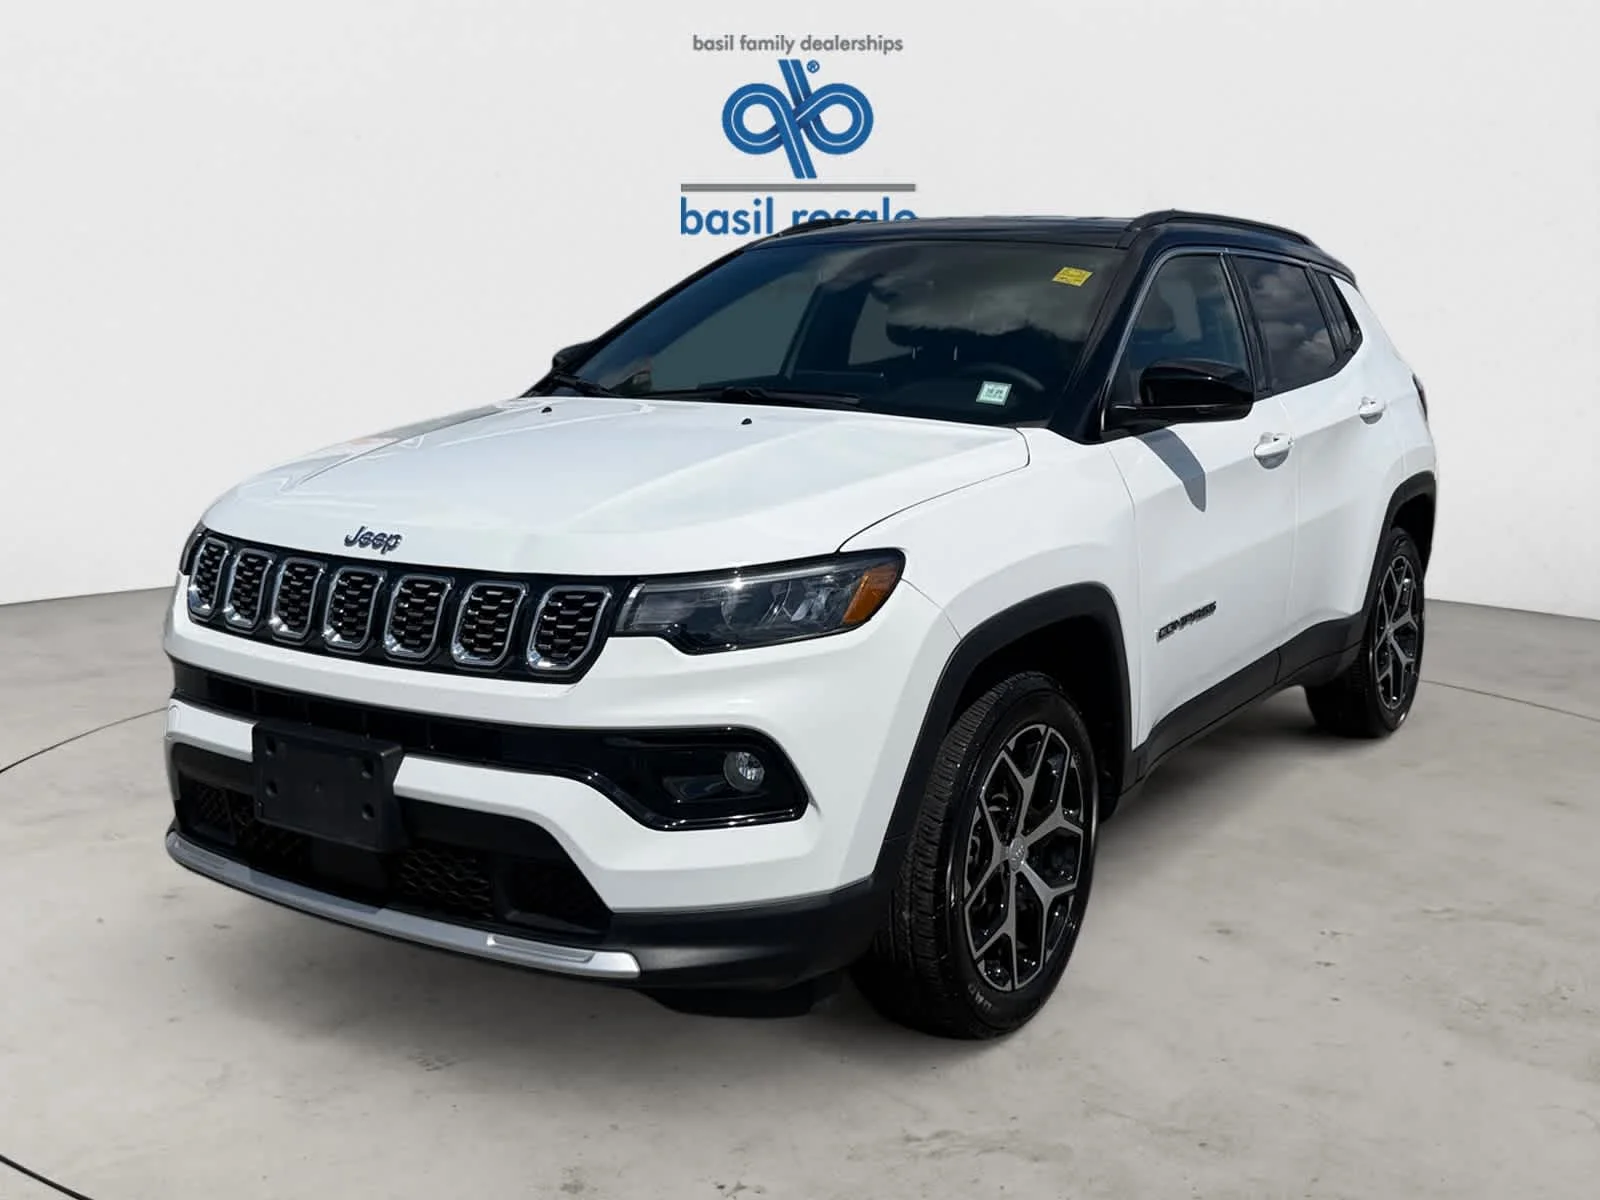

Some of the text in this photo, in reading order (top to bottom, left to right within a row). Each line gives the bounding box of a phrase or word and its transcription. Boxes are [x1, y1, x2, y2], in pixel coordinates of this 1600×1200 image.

[692, 35, 904, 55] basil family dealerships
[680, 196, 774, 236] basil
[344, 525, 403, 555] Jeep
